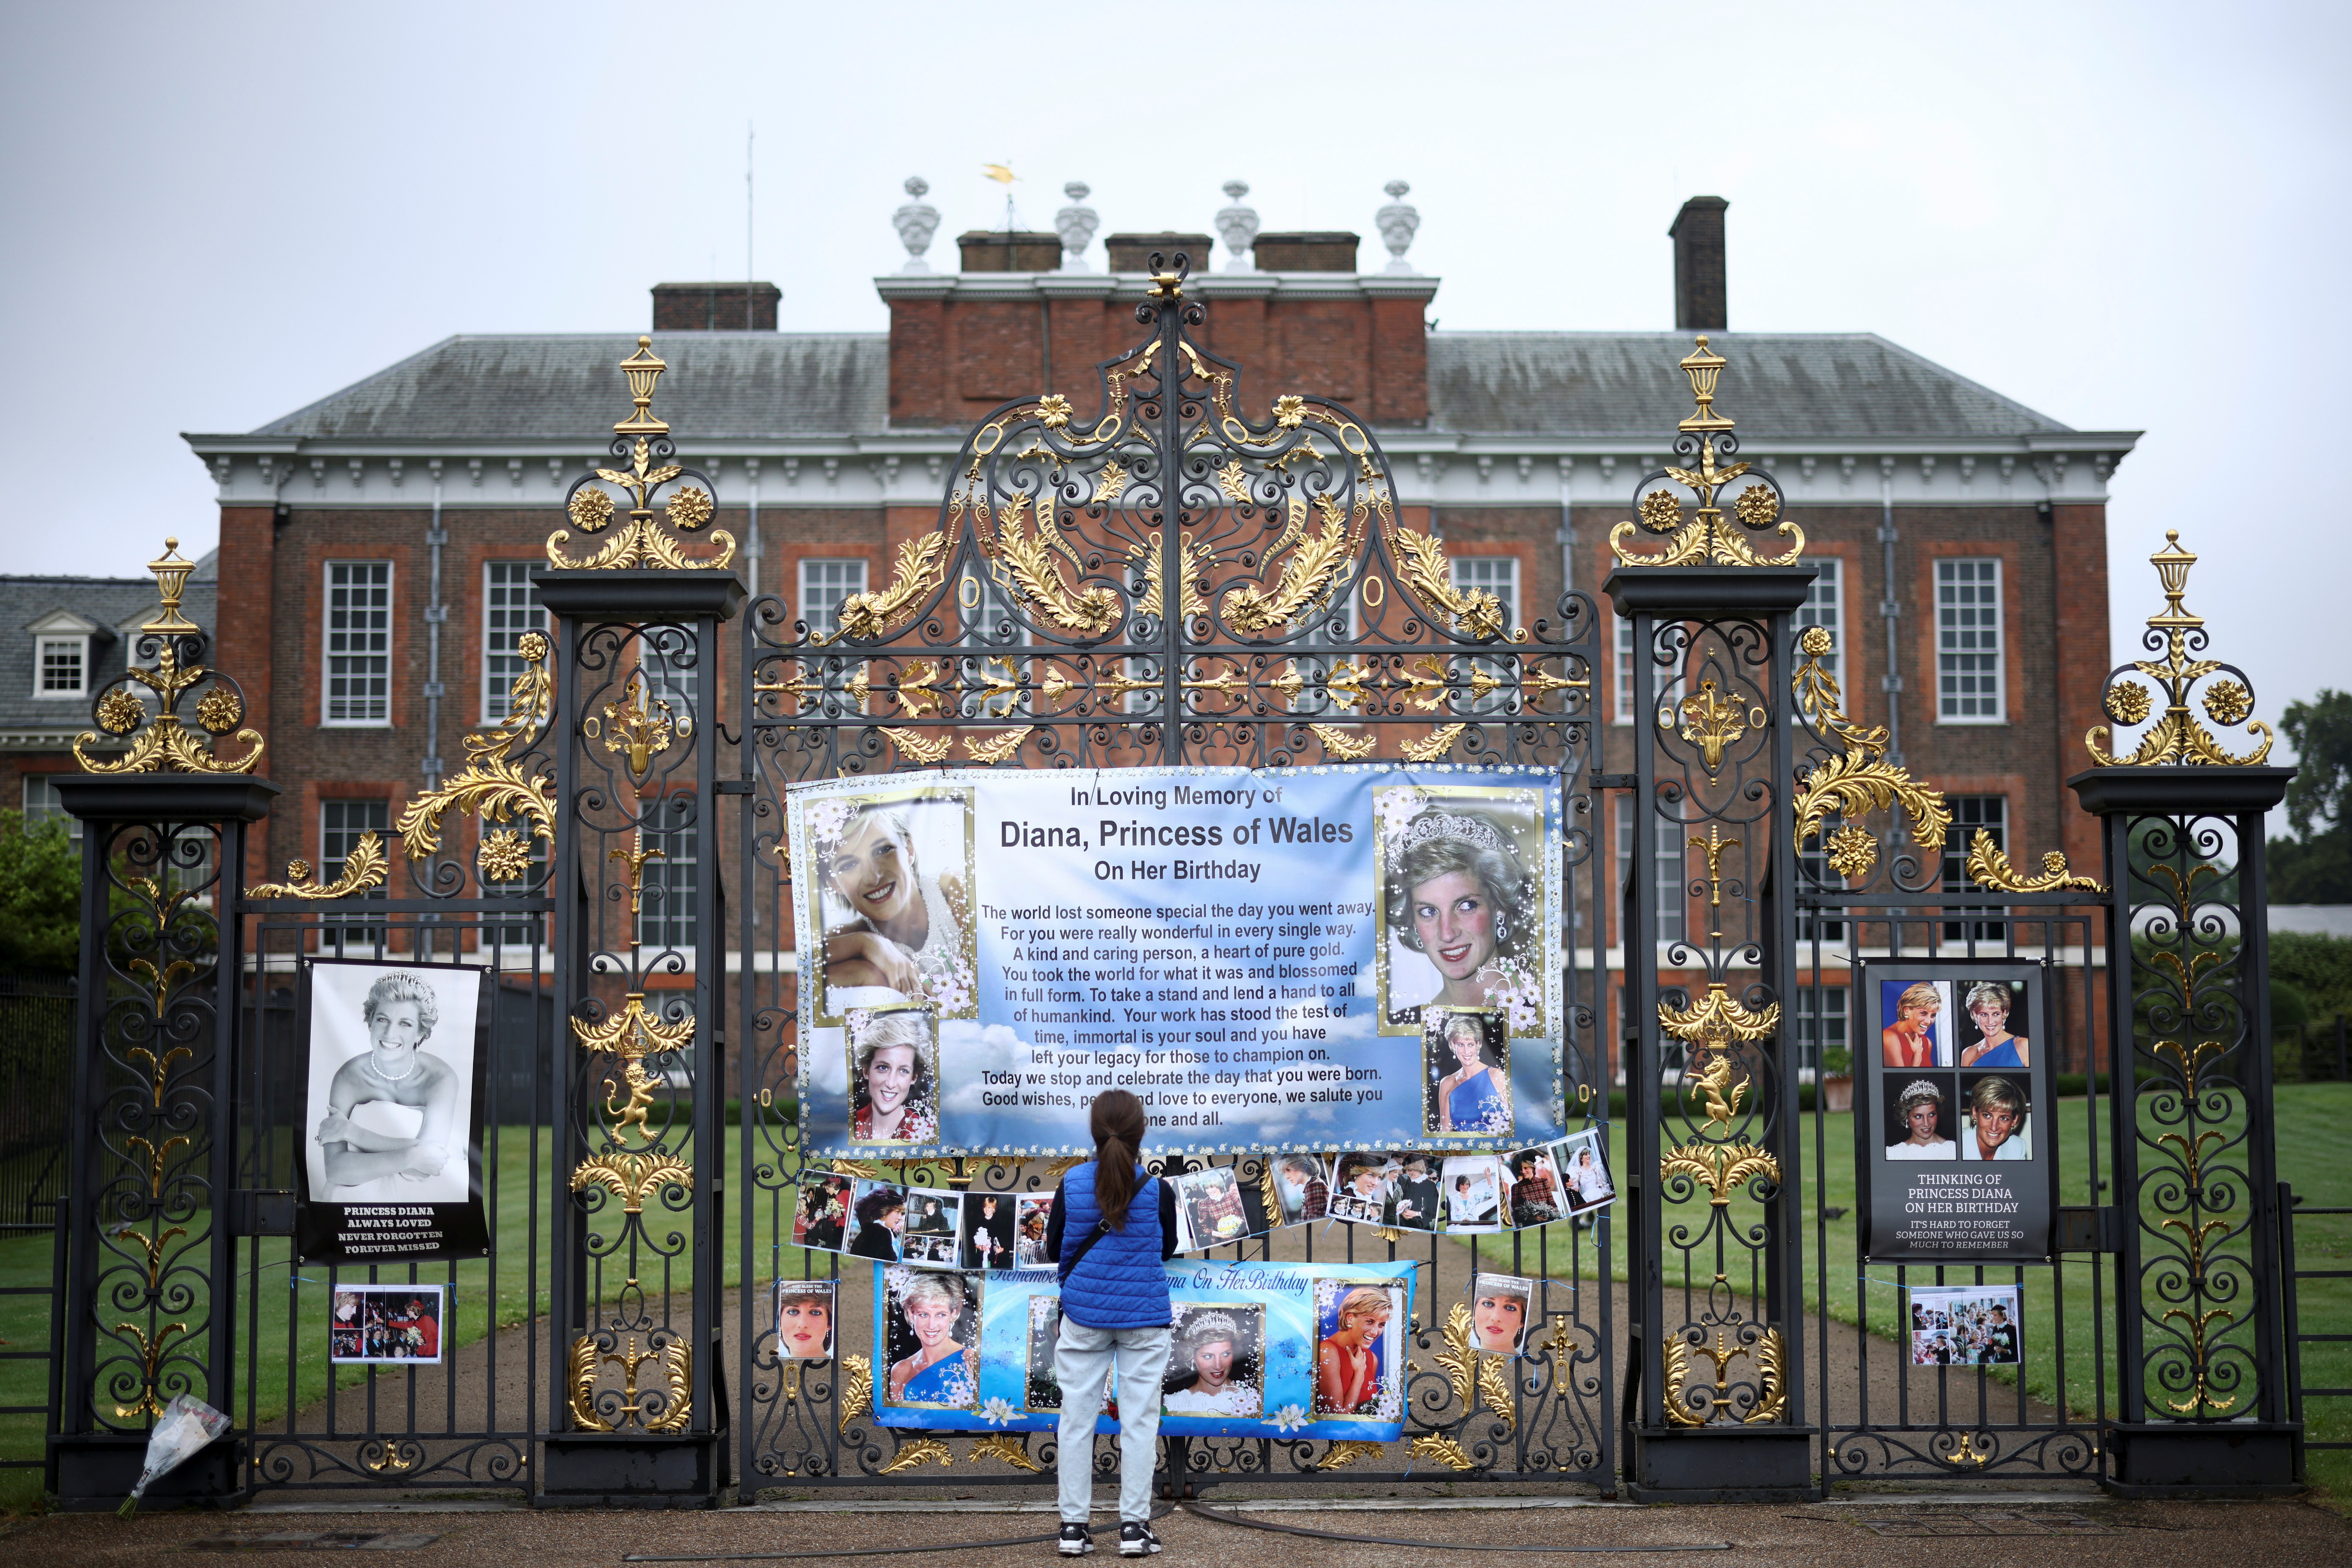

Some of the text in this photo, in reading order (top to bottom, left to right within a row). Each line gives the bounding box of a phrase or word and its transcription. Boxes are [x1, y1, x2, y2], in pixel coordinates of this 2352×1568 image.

[1072, 786, 1282, 810] In Loving Memory of
[1002, 817, 1353, 852] Diana, Princess of Wales
[1095, 859, 1261, 883] On Her Birthday
[982, 902, 1376, 921] The world lost someone special the day you went away.
[1002, 922, 1356, 944] For you were really wonderful in every single way.
[1013, 942, 1344, 963] A kind and caring person, a heart of pure gold.
[1002, 962, 1357, 981] You took the world for what it was and blossomed
[1005, 983, 1355, 1002] in full form. To take a stand and lend a hand to all
[1014, 1004, 1347, 1023] of humankind. Your work has stood the test of
[1034, 1026, 1326, 1046] time, immortal is your soul and you have
[1032, 1047, 1330, 1068] left your legacy for those to champion on.
[982, 1067, 1382, 1088] Today we stop and celebrate the day that you were born.
[983, 1091, 1018, 1106] Good
[1022, 1091, 1075, 1108] wishes,
[1136, 1091, 1153, 1105] nd
[1159, 1091, 1188, 1105] love
[1193, 1091, 1206, 1104] to
[1211, 1093, 1281, 1107] everyone,
[1286, 1092, 1305, 1102] we
[1310, 1088, 1352, 1102] salute
[1356, 1090, 1382, 1104] you
[1171, 1112, 1197, 1126] and
[1203, 1111, 1222, 1125] all.
[1918, 1174, 2002, 1184] THINKING OF
[1909, 1188, 2012, 1199] PRINCESS DIANA
[344, 1207, 434, 1215] PRINCESS DIANA
[1905, 1203, 2018, 1213] ON HER BIRTHDAY
[348, 1219, 432, 1228] ALWAYS LOVED
[376, 1231, 443, 1240] FORGOTTEN
[345, 1243, 440, 1254] FOREVER MISSED
[1193, 1268, 1213, 1289] On
[1217, 1269, 1246, 1290] Her
[1245, 1269, 1309, 1296] Birthday
